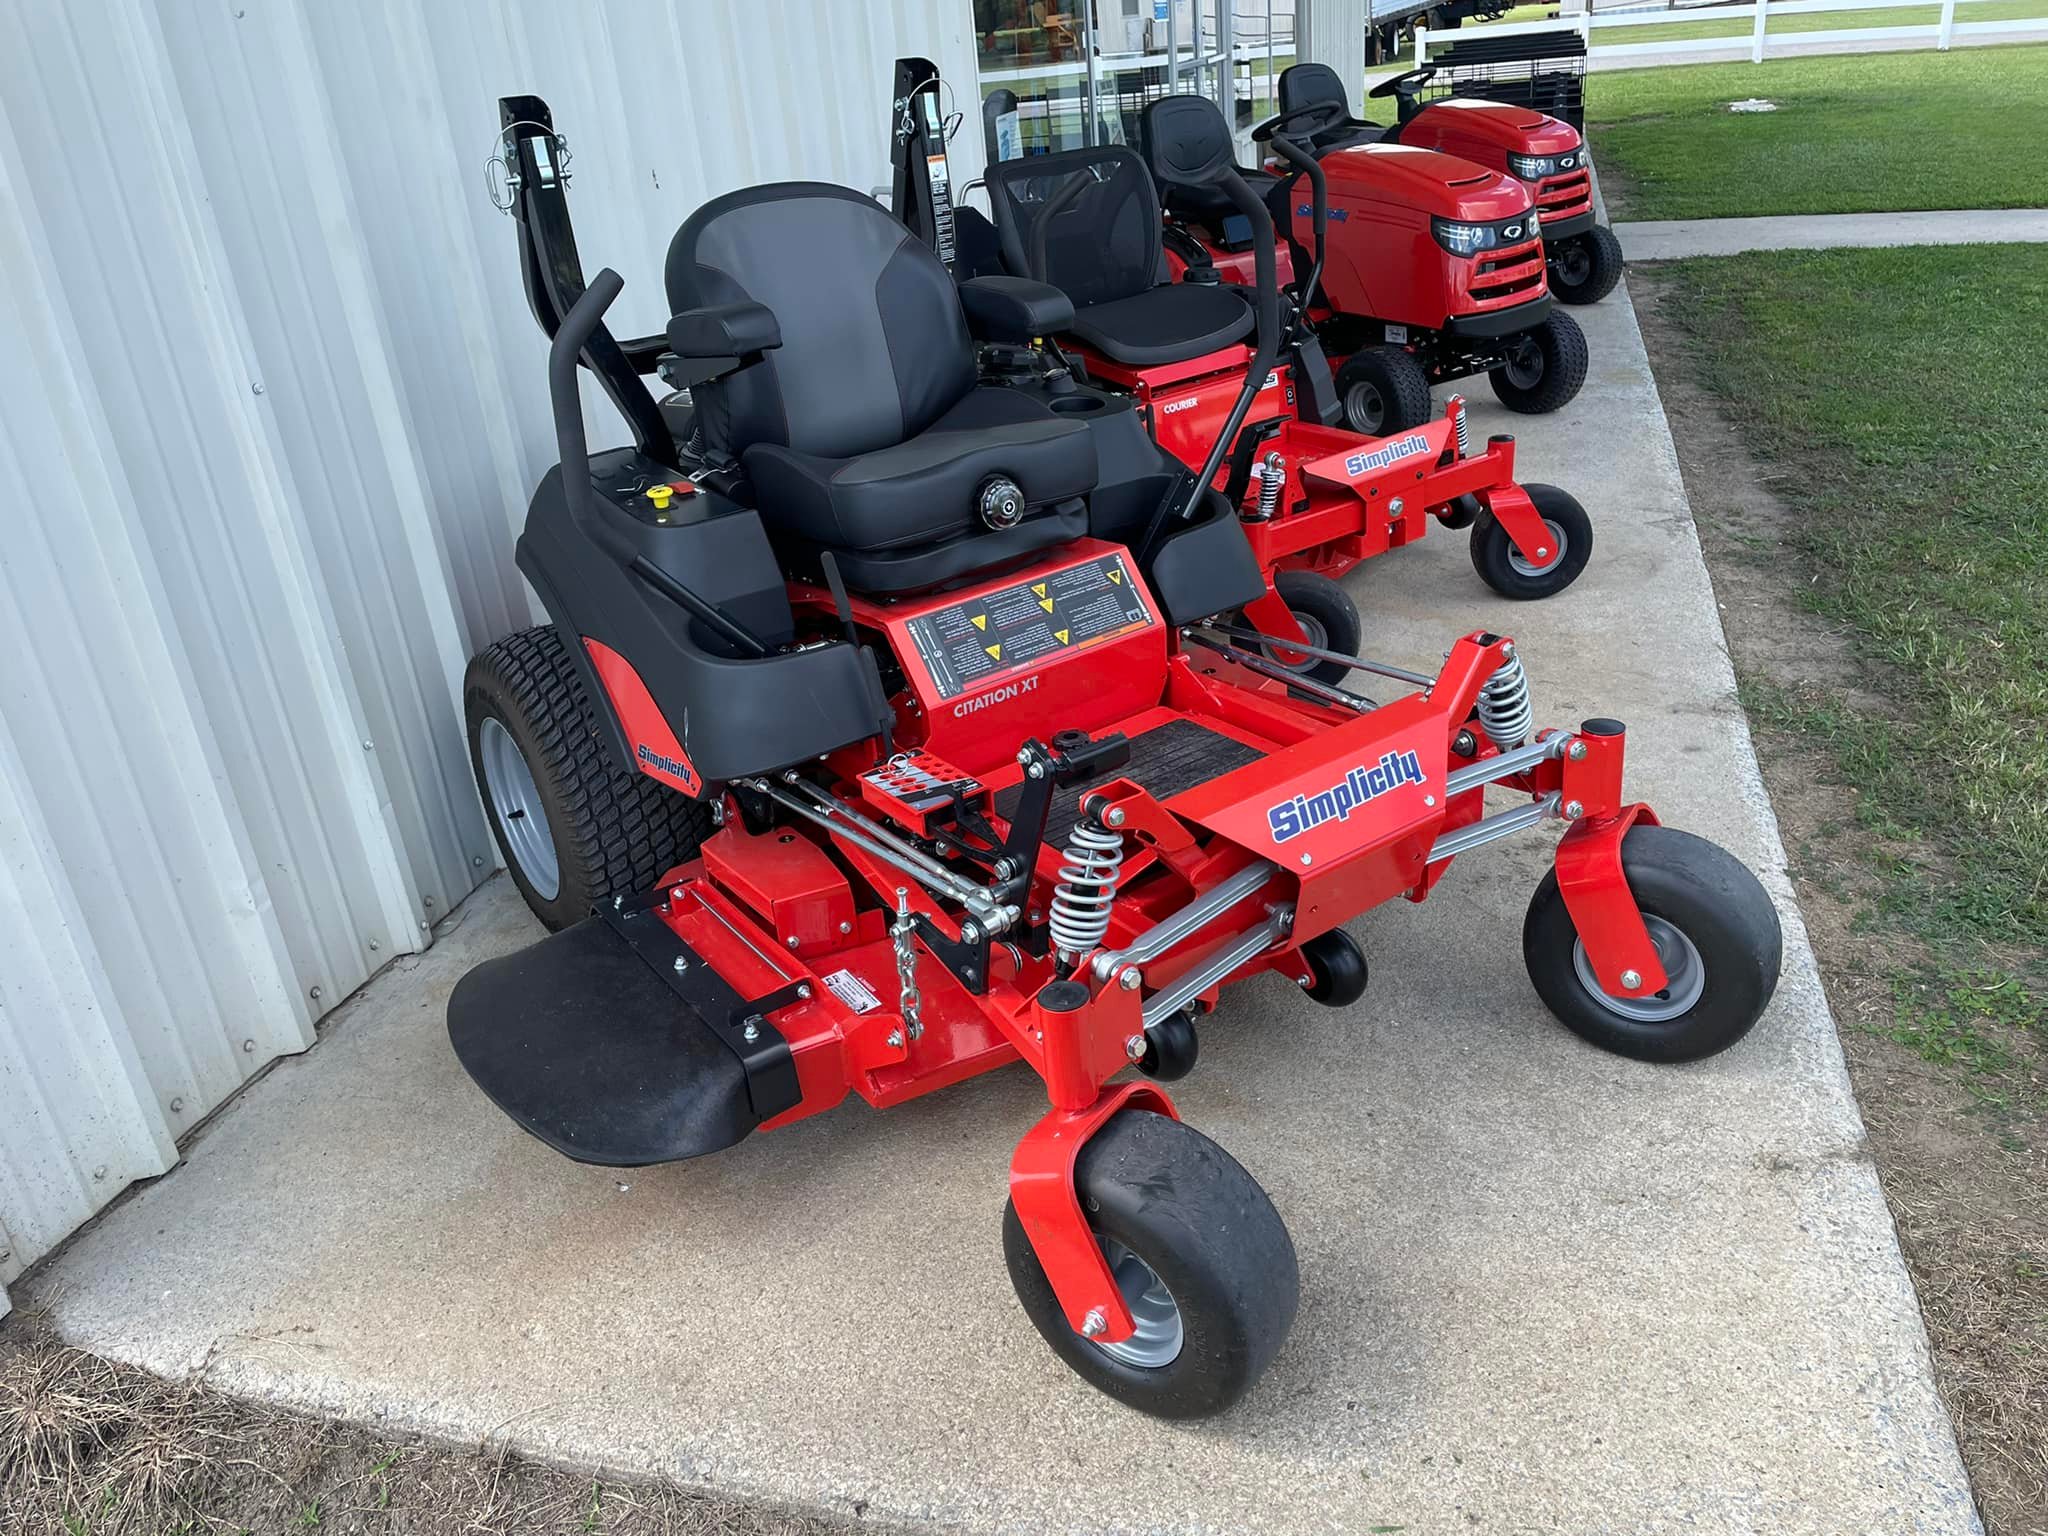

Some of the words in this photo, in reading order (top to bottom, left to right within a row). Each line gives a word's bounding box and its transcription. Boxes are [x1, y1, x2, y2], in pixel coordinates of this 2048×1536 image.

[1163, 397, 1198, 415] COURIER
[1345, 434, 1431, 477] Simplicity
[953, 685, 1018, 718] CITATION
[1021, 675, 1039, 694] XT
[638, 743, 692, 785] Simplicity
[1268, 750, 1426, 843] Simplicity
